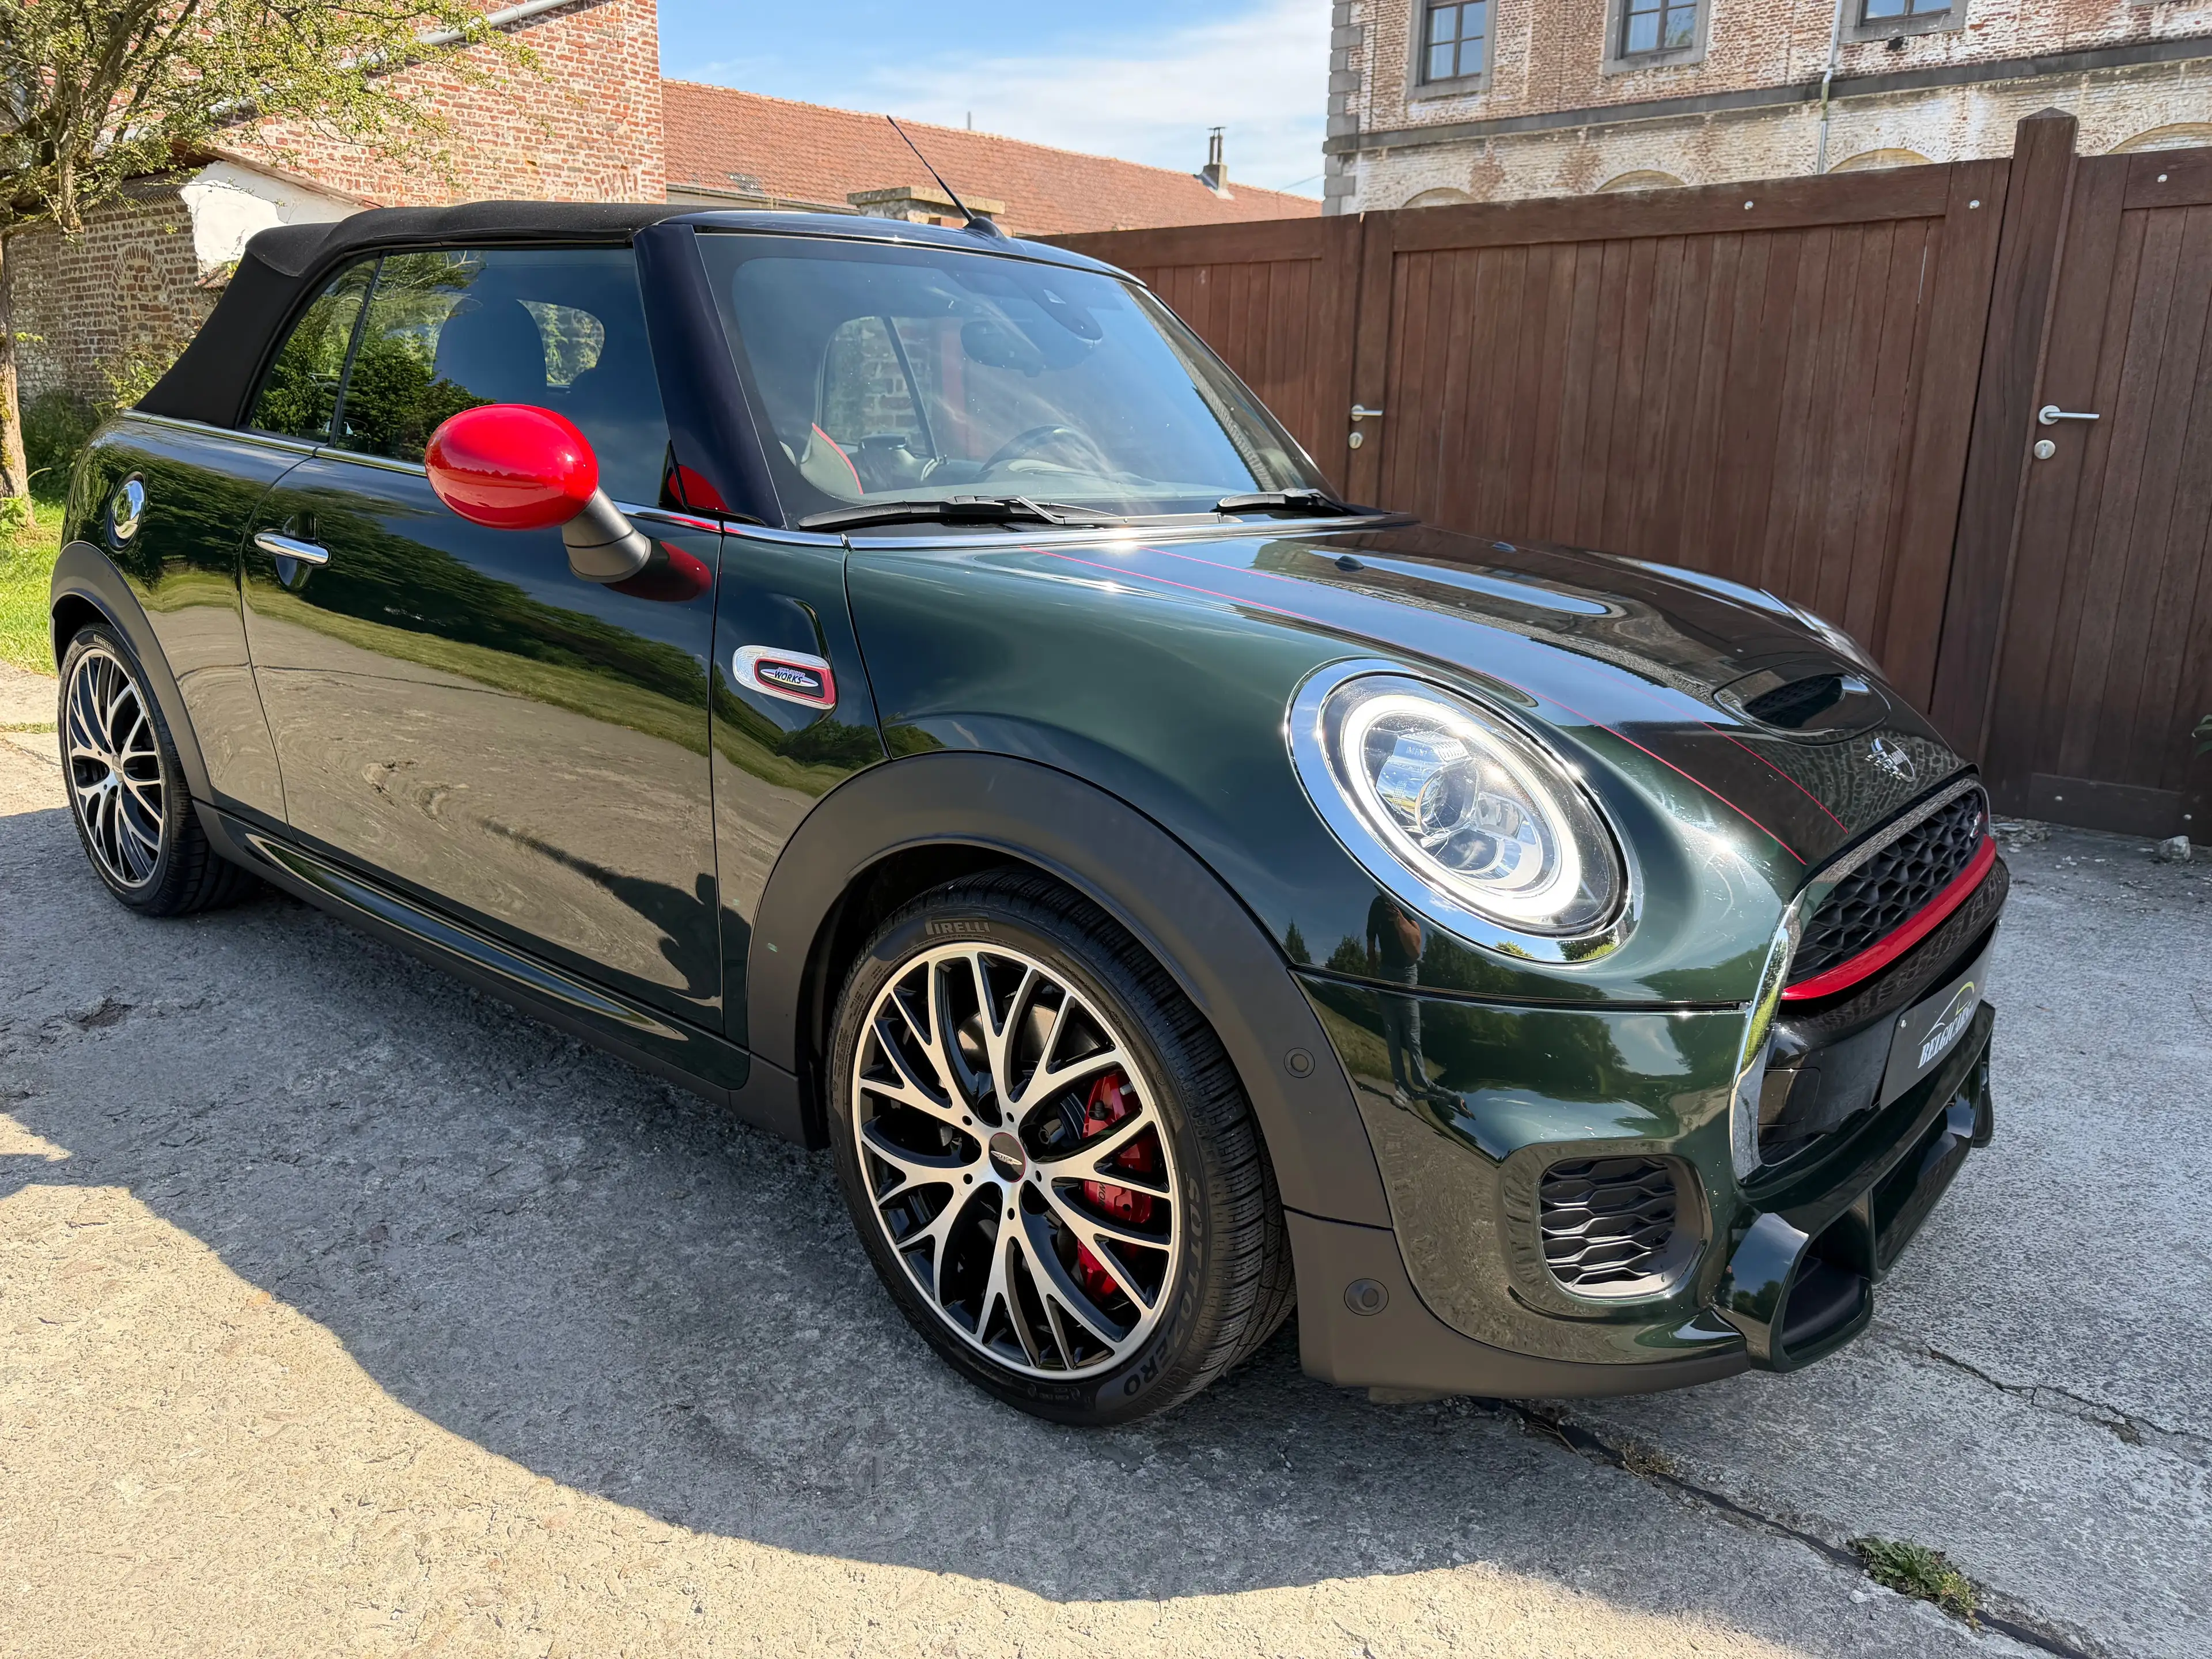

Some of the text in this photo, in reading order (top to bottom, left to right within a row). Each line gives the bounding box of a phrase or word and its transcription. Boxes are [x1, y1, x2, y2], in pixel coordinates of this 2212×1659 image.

[93, 634, 115, 654] PIRELLI
[775, 671, 803, 684] WORKS
[925, 916, 991, 935] PIRELLI
[998, 1154, 1013, 1162] WORKS
